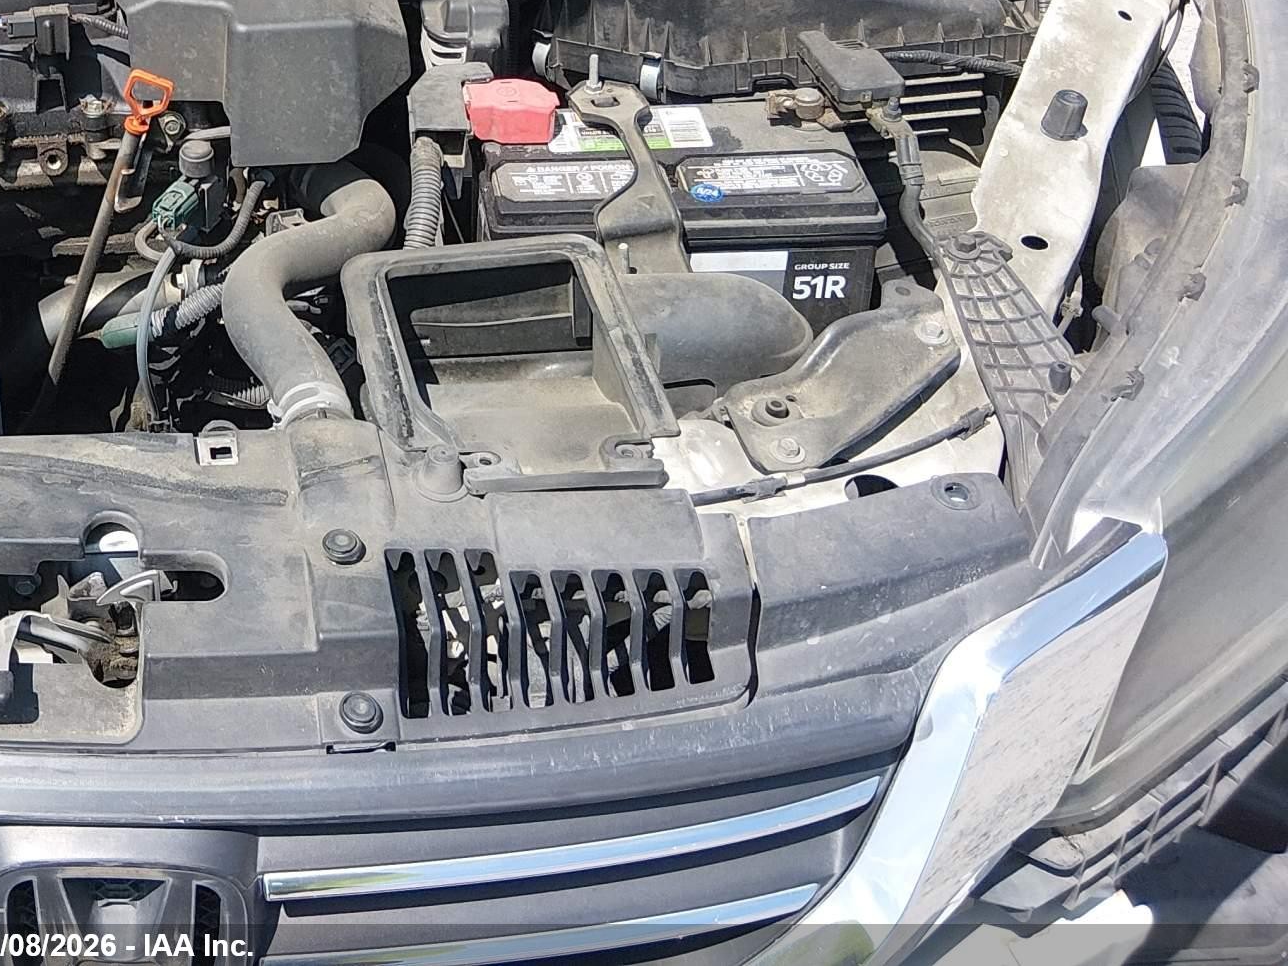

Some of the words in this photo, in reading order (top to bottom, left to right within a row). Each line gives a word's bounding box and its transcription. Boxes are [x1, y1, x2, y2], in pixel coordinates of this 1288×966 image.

[794, 263, 828, 271] GROUP
[828, 262, 850, 270] SIZE
[792, 275, 846, 300] 51R
